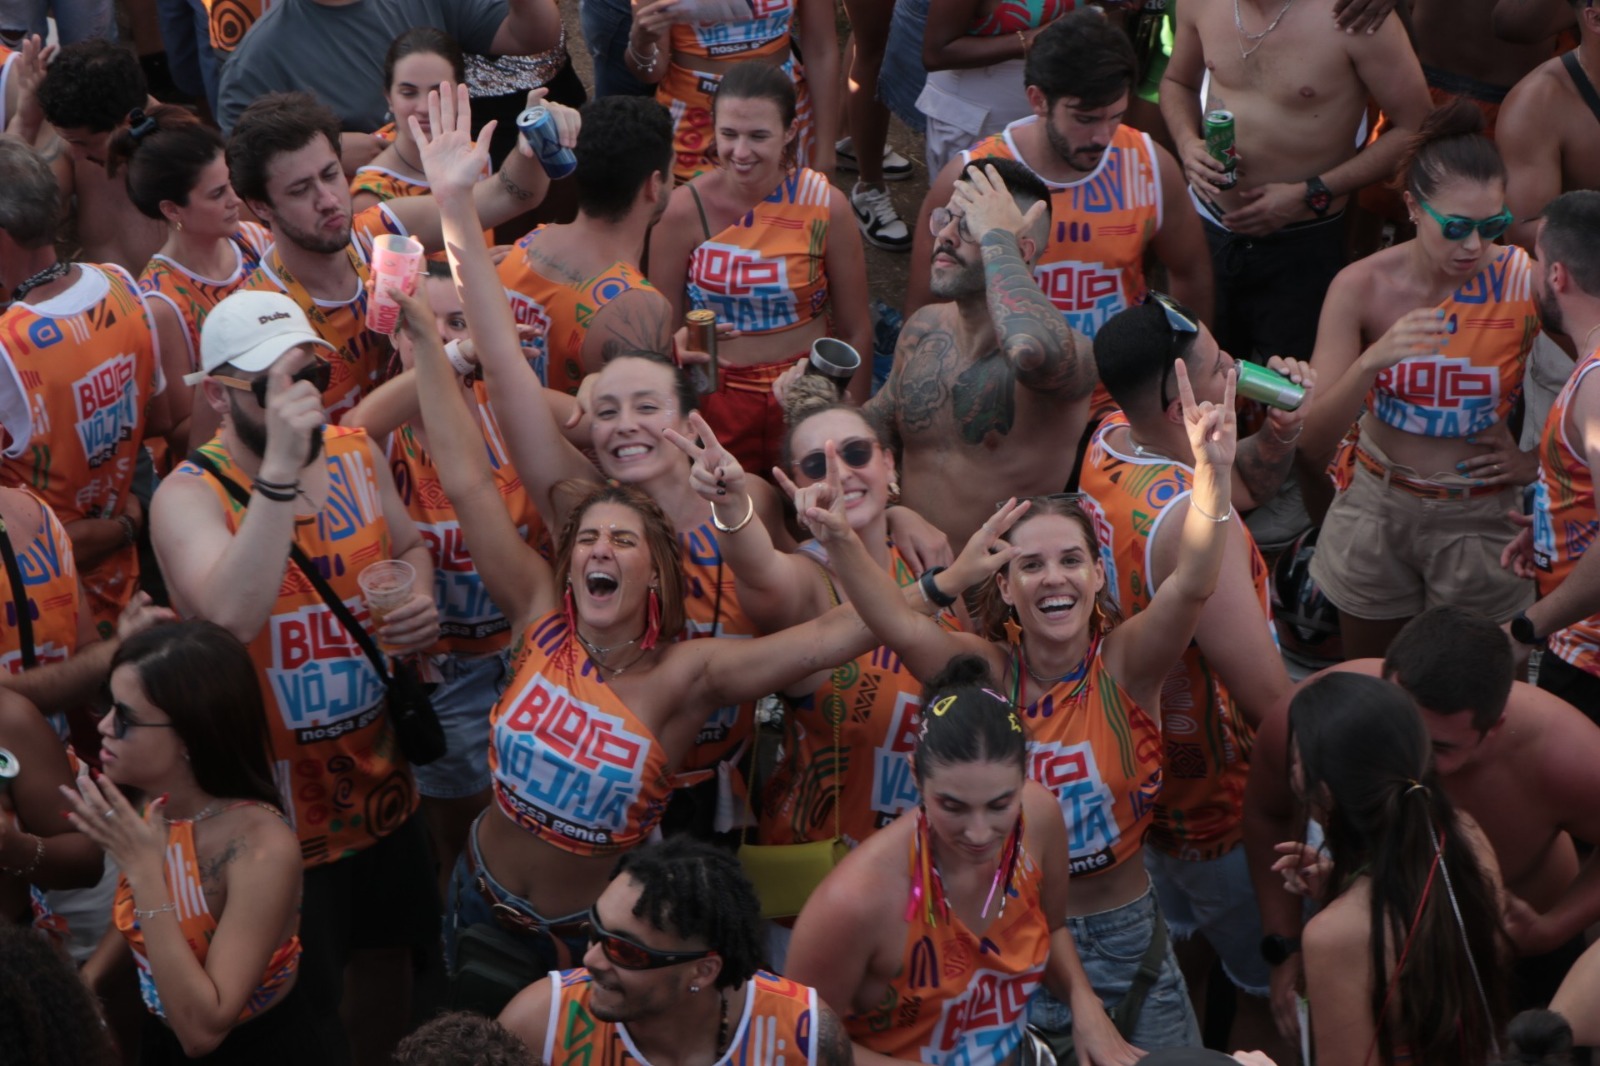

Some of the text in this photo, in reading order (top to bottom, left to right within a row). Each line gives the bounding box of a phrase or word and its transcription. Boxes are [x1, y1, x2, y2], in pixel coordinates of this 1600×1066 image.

[1033, 267, 1118, 312] LOCO
[302, 720, 354, 741] nossa
[506, 683, 641, 770] BLOCO
[500, 786, 608, 844] nossa gente
